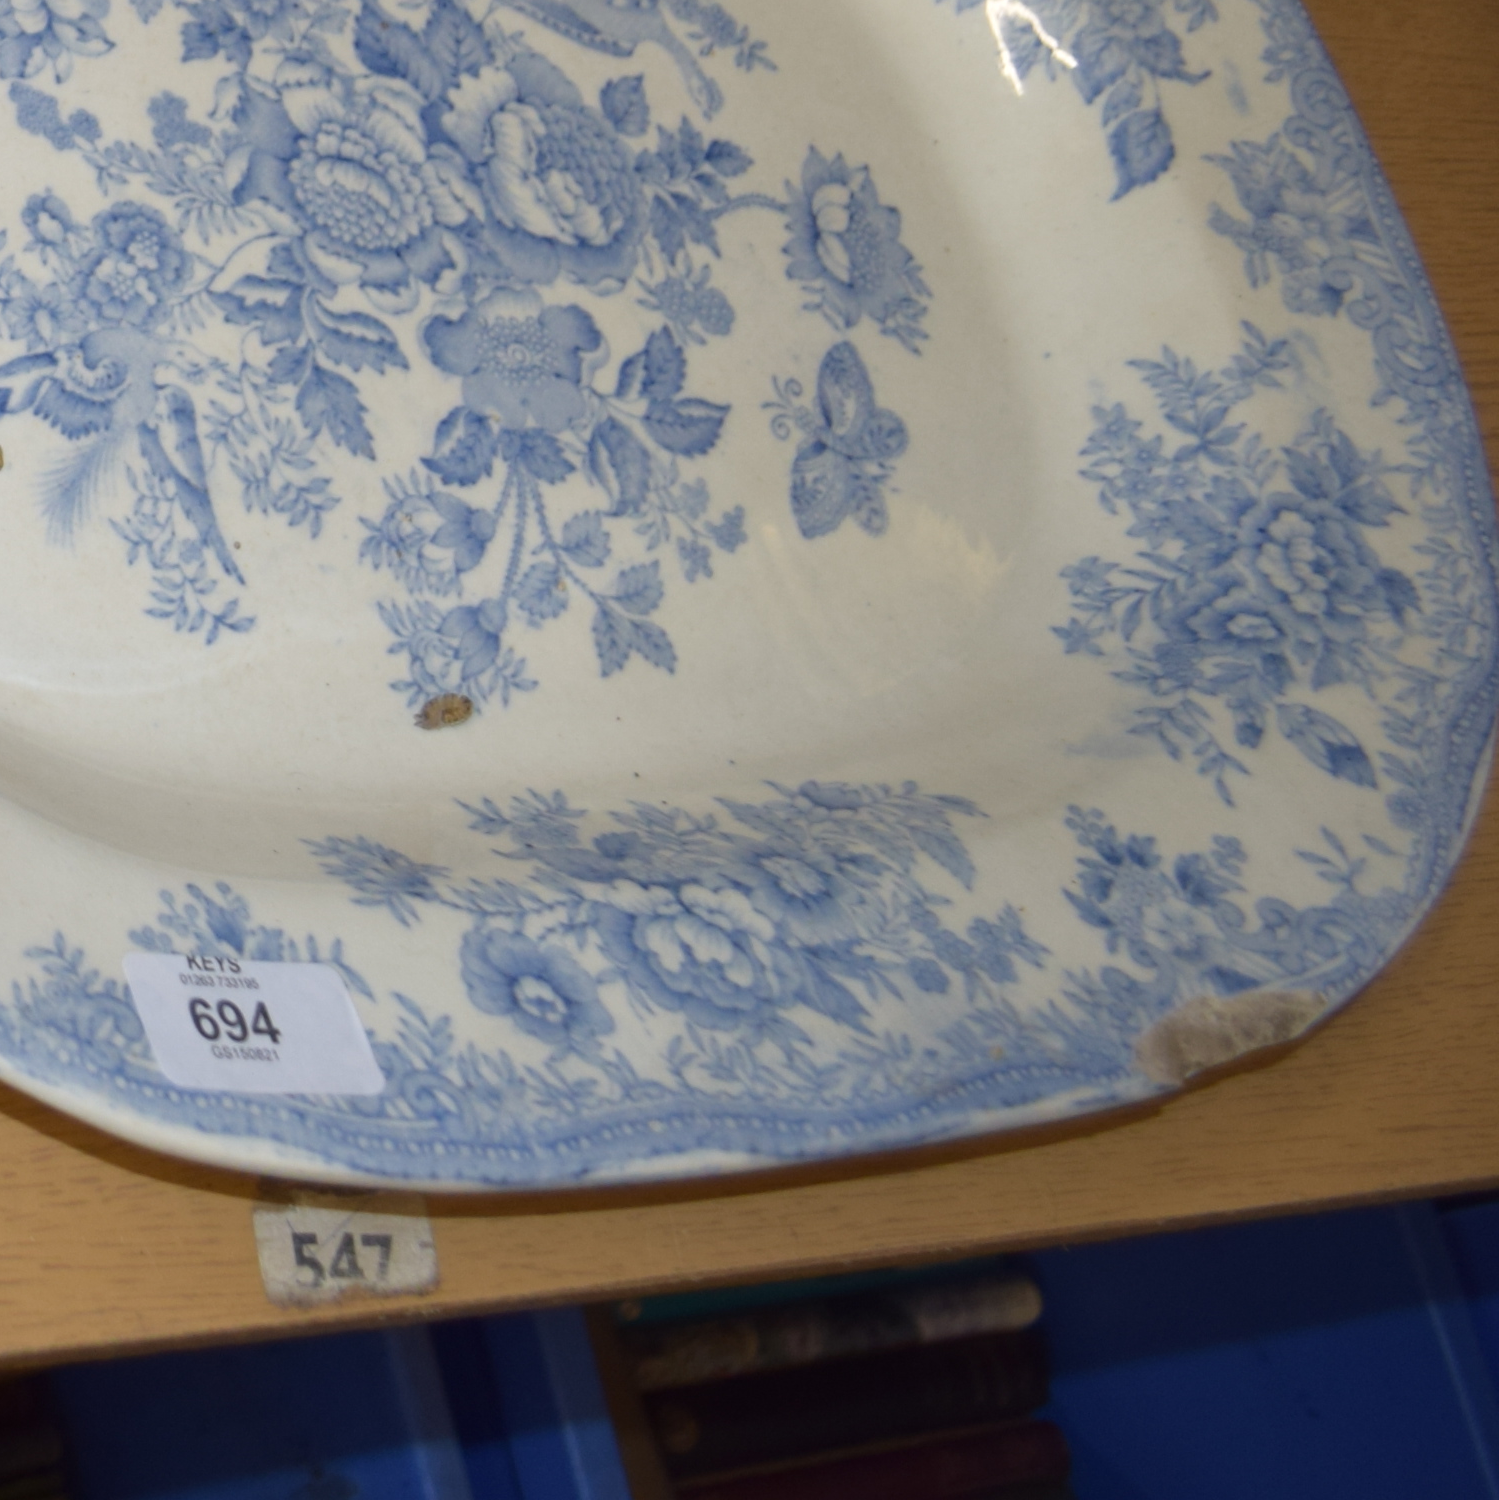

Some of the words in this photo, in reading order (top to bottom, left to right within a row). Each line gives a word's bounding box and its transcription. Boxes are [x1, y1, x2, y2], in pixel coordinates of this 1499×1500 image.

[185, 955, 242, 974] KEYS
[188, 997, 282, 1045] 694
[291, 1231, 393, 1289] 547
